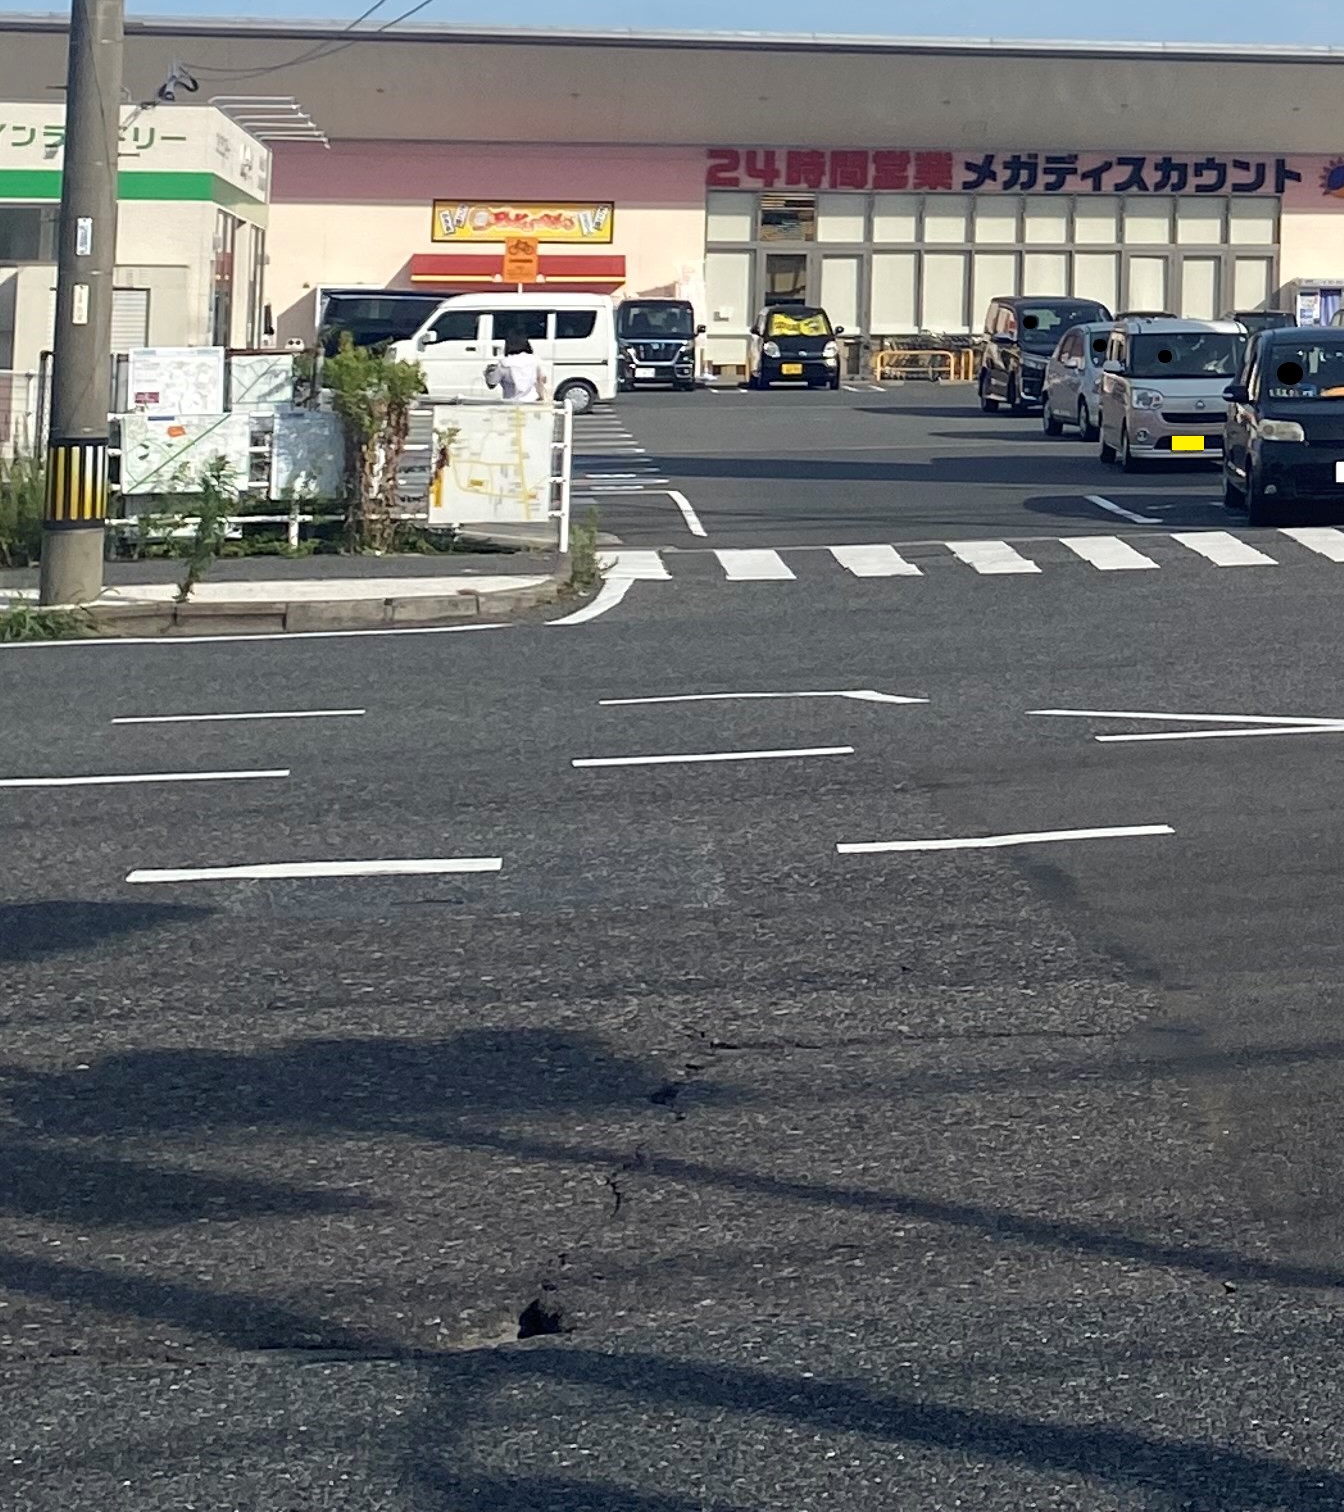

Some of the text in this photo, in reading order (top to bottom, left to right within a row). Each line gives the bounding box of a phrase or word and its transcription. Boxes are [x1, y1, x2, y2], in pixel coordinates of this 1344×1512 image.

[706, 149, 954, 190] 24時間営業
[962, 153, 1302, 194] メガディスカウント
